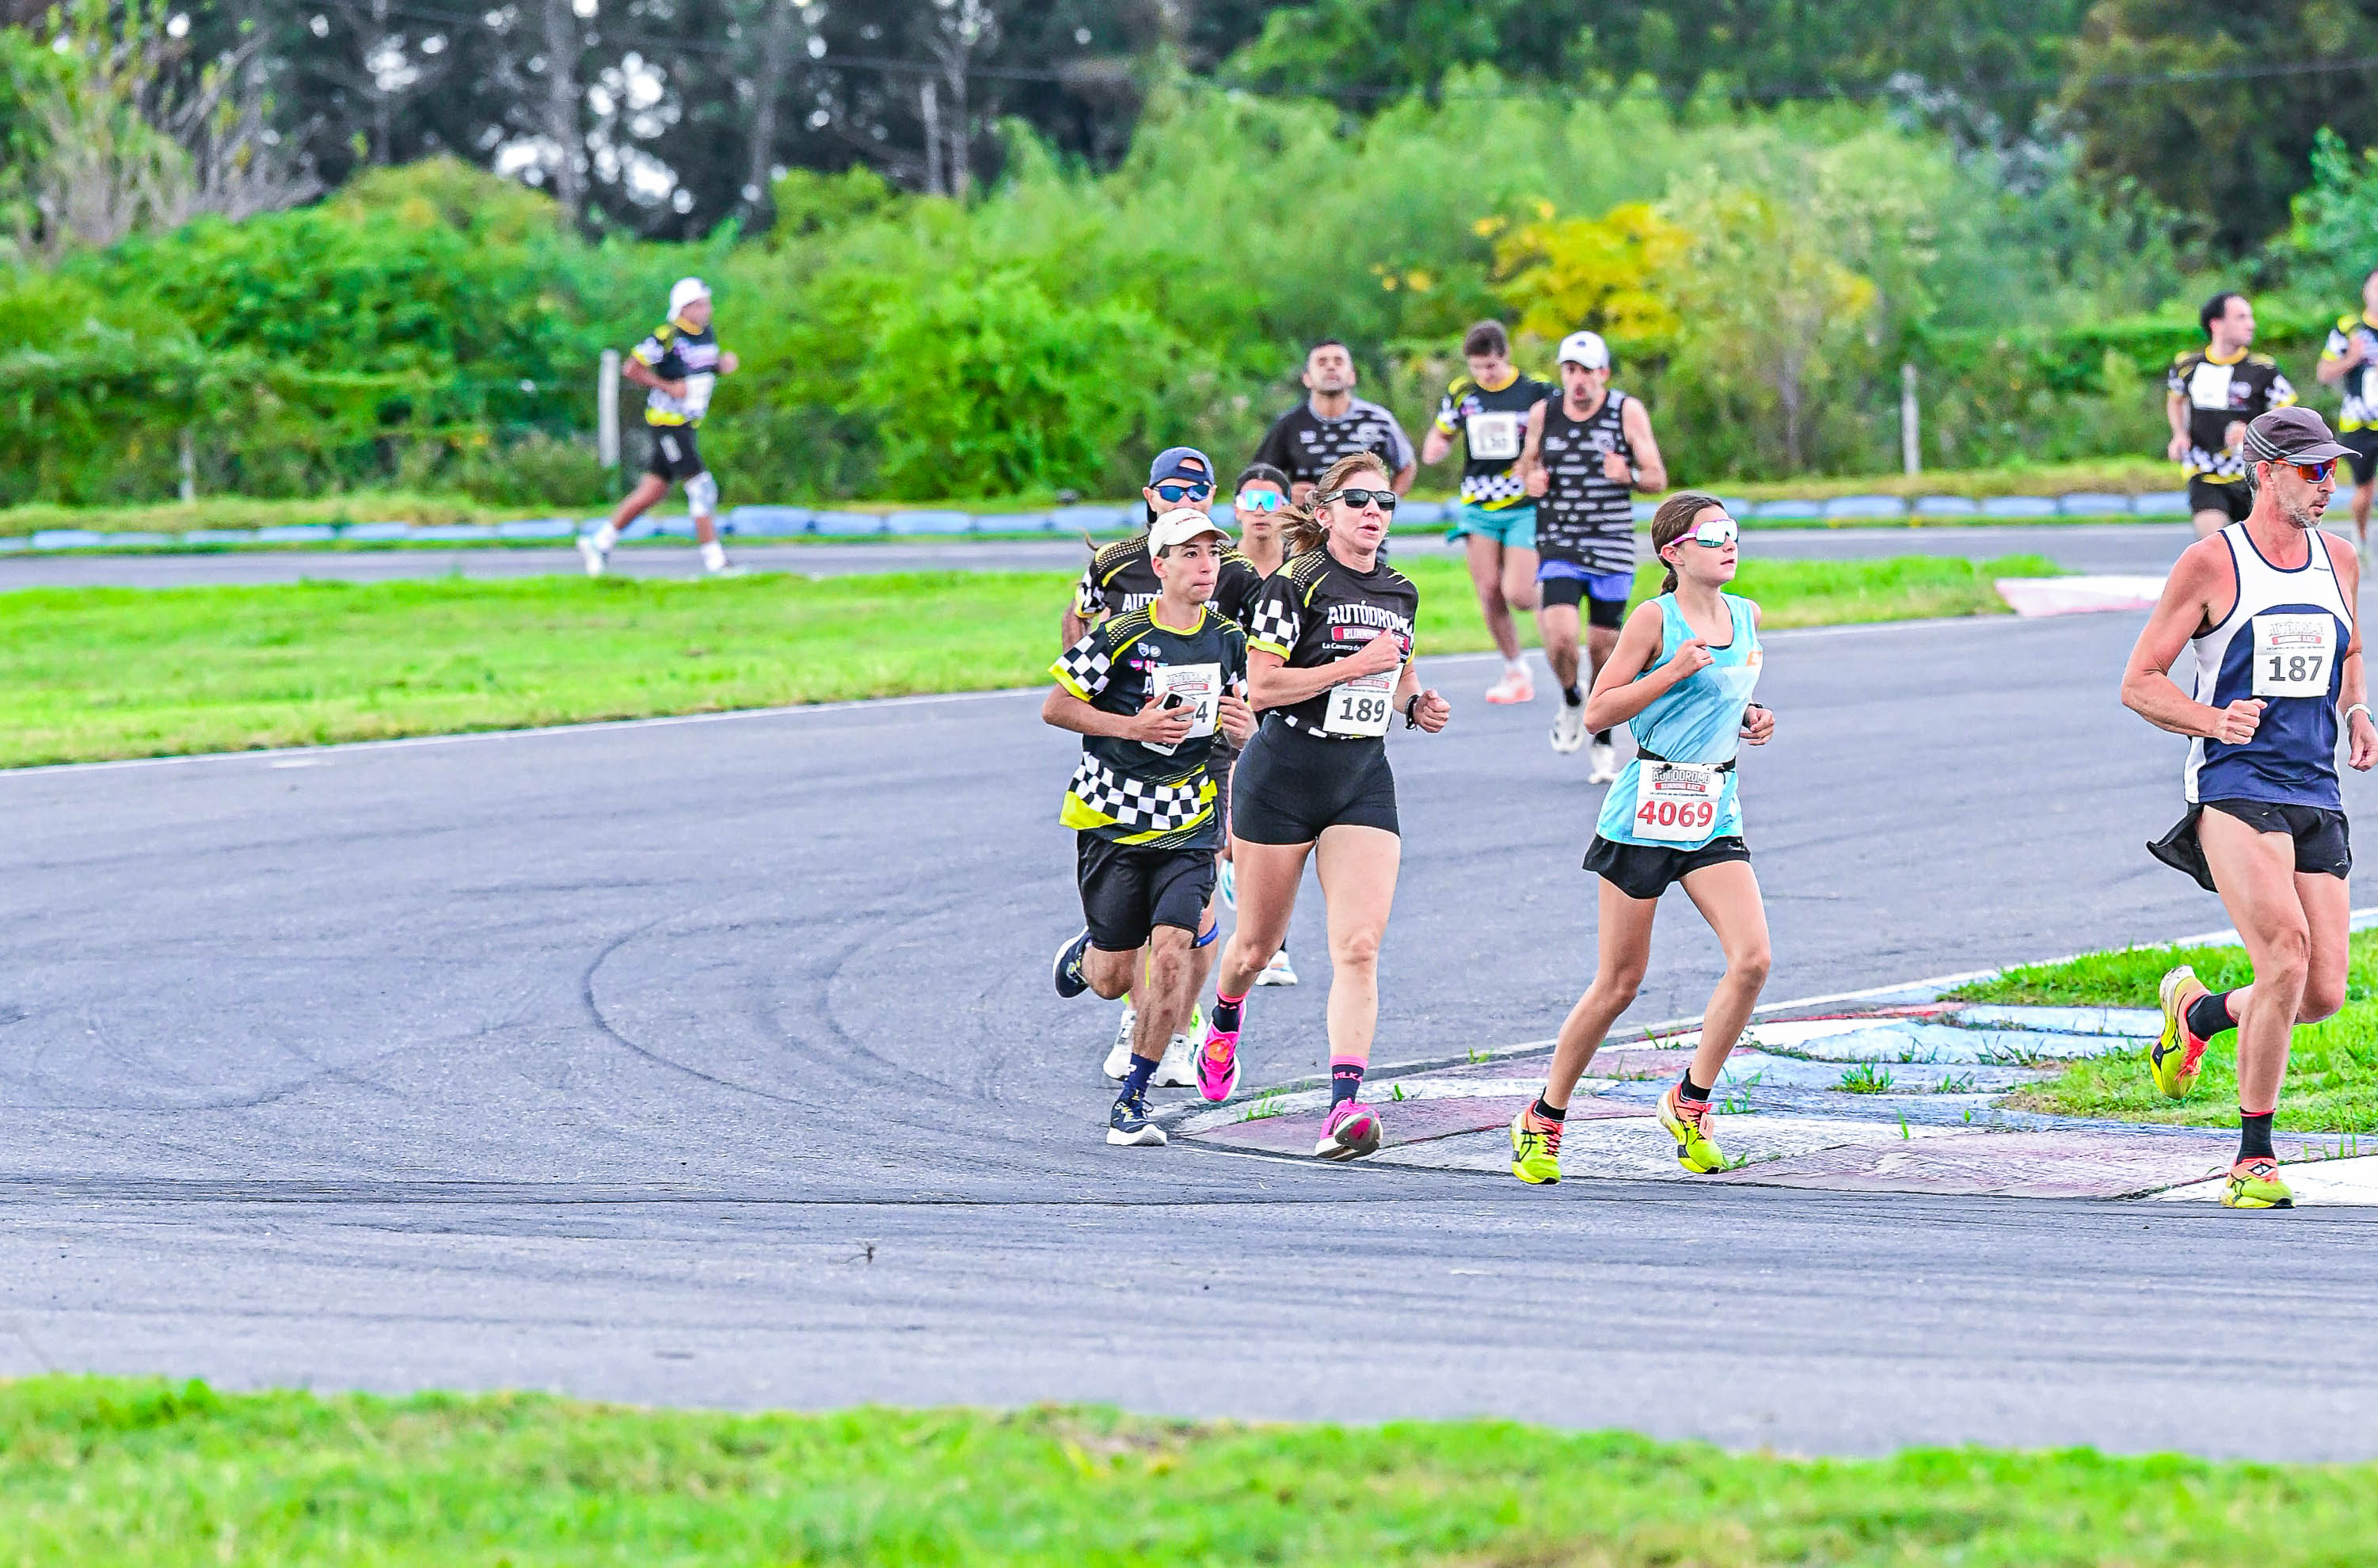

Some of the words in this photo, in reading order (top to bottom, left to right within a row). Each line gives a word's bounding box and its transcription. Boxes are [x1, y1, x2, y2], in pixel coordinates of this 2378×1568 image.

[2269, 656, 2323, 682] 187
[1339, 697, 1385, 723] 189
[1637, 801, 1713, 828] 4069
